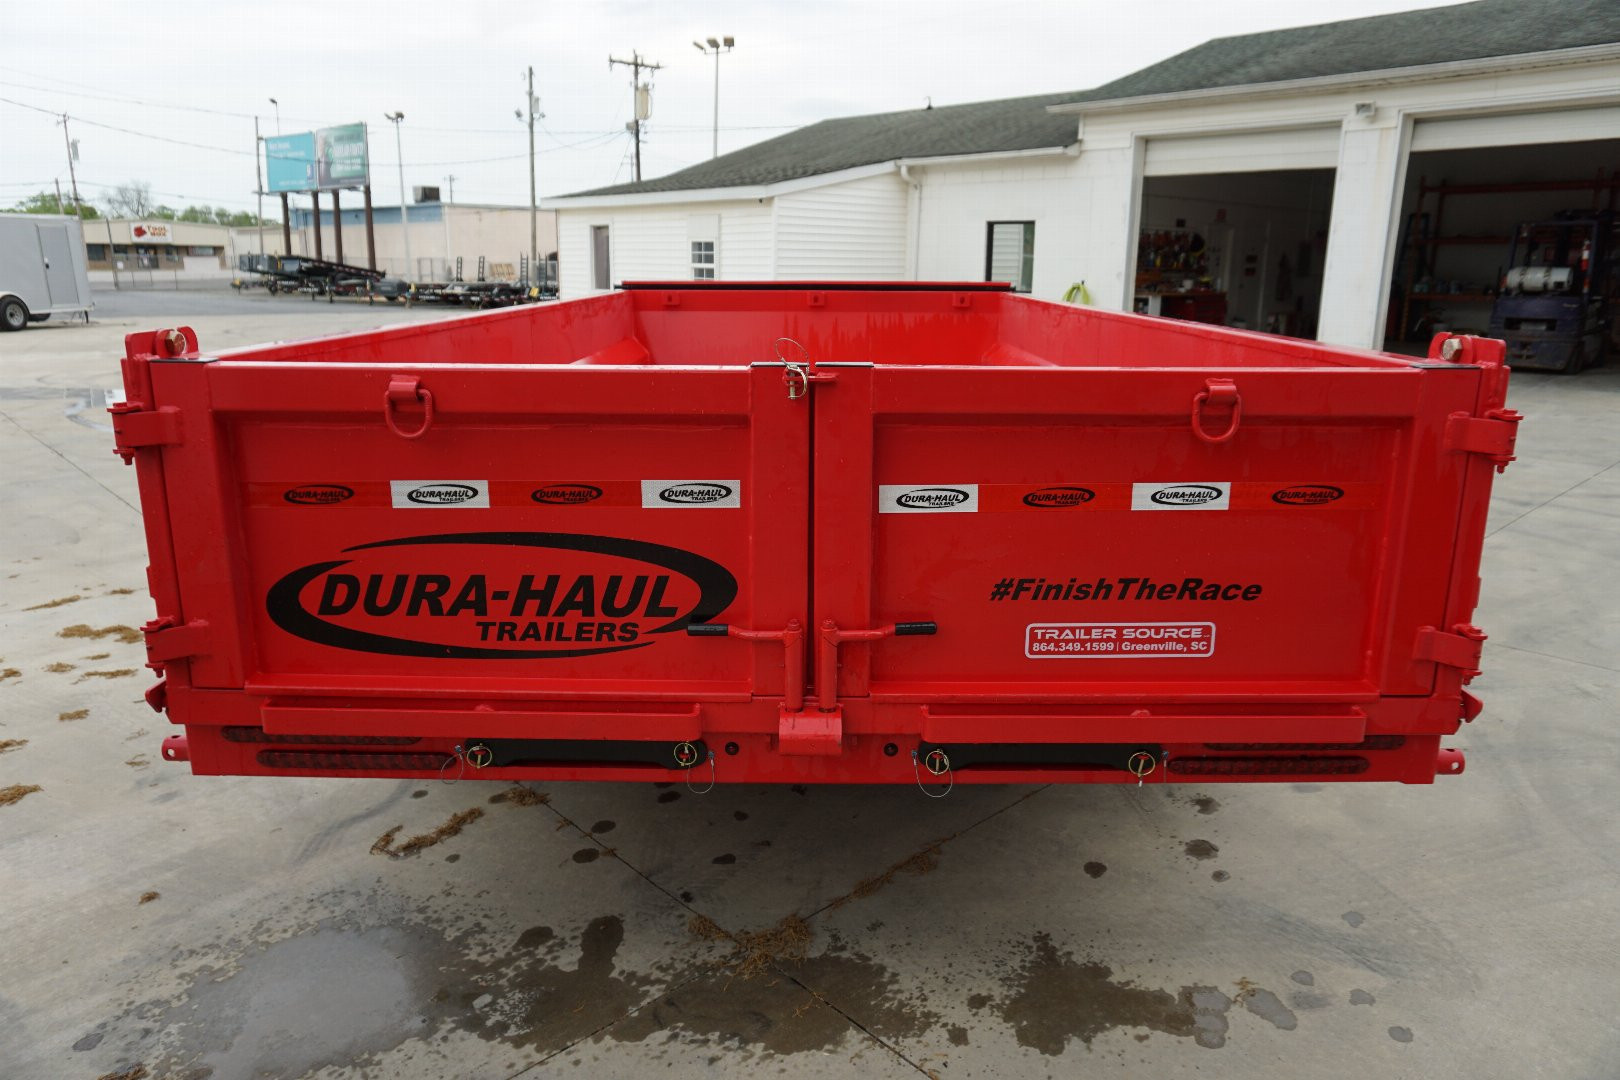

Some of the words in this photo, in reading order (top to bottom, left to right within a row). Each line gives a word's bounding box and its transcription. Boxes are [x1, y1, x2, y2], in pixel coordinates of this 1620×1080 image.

[291, 489, 345, 499] DURA-HAUL
[415, 489, 470, 498] DURA-HAUL
[539, 489, 594, 498] DURA-HAUL
[667, 488, 723, 497] DURA-HAUL
[1031, 492, 1087, 501] DURA-HAUL
[1158, 491, 1214, 500] DURA-HAUL
[1279, 490, 1336, 499] DURA-HAUL
[904, 493, 961, 503] DURA-HAUL
[990, 577, 1263, 601] #FinishTheRace
[317, 574, 680, 618] DURA-HAUL
[475, 621, 640, 642] TRAILERS
[1033, 628, 1117, 640] TRAILER
[1122, 627, 1203, 639] SOURCE
[1032, 642, 1115, 652] 864.349.1599
[1121, 641, 1187, 653] Greenville,
[1190, 641, 1208, 651] SC
